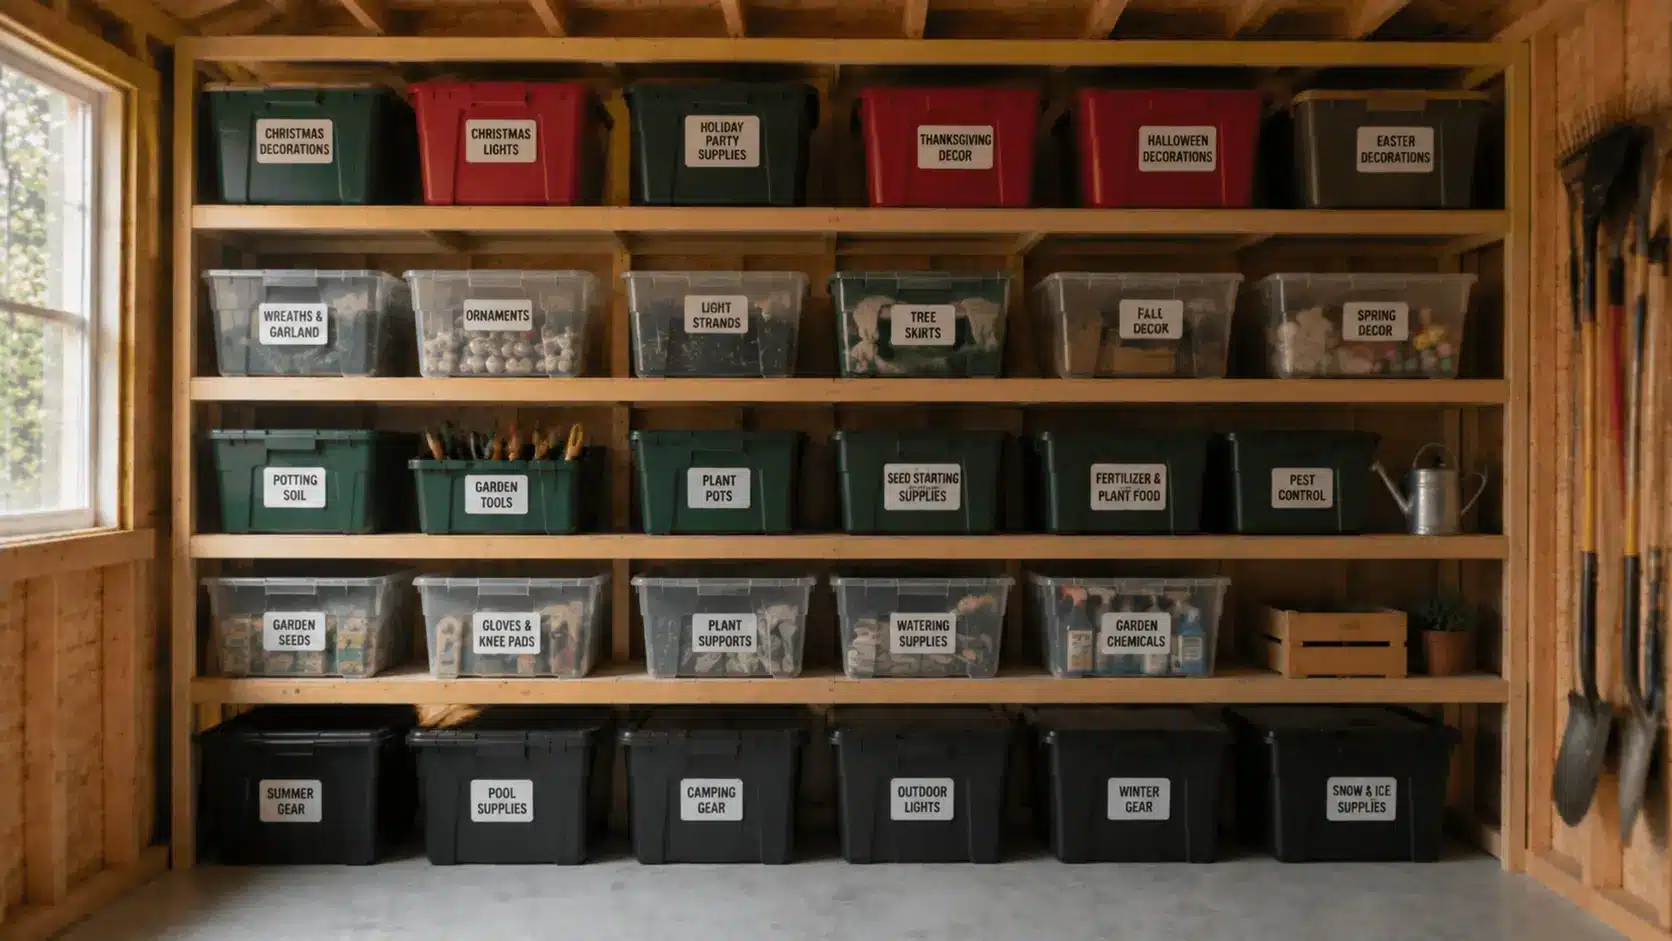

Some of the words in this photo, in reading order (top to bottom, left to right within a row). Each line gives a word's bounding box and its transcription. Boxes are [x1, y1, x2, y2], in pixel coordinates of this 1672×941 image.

[701, 122, 744, 133] HOLIDAY
[265, 128, 324, 139] CHRISTMAS
[471, 128, 531, 140] CHRISTMAS
[706, 135, 739, 146] PARTY
[921, 134, 991, 146] THANKSGIVING
[1148, 135, 1208, 146] HALLOWEEN
[1377, 135, 1415, 147] EASTER
[260, 144, 329, 155] DECORATIONS
[484, 144, 519, 155] LIGHTS
[698, 149, 747, 160] SUPPLIES
[939, 149, 972, 161] DECOR
[1143, 151, 1212, 162] DECORATIONS
[1361, 152, 1431, 163] DECORATIONS
[702, 302, 732, 313] LIGHT
[264, 310, 312, 322] WREATHS
[316, 310, 322, 322] &
[466, 310, 530, 321] ORNAMENTS
[911, 311, 936, 323] TREE
[1358, 310, 1396, 321] SPRING
[693, 317, 741, 328] STRANDS
[270, 326, 319, 338] GARLAND
[905, 327, 941, 339] SKIRTS
[1358, 325, 1392, 336] DECOR
[273, 474, 317, 485] POTTING
[703, 475, 736, 486] PLANT
[888, 472, 911, 484] SEED
[913, 472, 959, 484] STARTING
[1096, 472, 1151, 484] FERTILIZER
[1154, 472, 1161, 484] &
[1290, 474, 1315, 486] PEST
[476, 481, 518, 492] GARDEN
[283, 490, 306, 500] SOIL
[706, 490, 732, 502] POTS
[899, 490, 947, 502] SUPPLIES
[1099, 490, 1131, 502] PLANT
[1133, 490, 1160, 502] FOOD
[1278, 490, 1327, 501] CONTROL
[481, 497, 513, 508] TOOLS
[273, 619, 315, 630] GARDEN
[483, 620, 522, 631] GLOVES
[525, 620, 532, 631] &
[709, 620, 742, 631] PLANT
[897, 620, 950, 631] WATERING
[1116, 620, 1158, 631] GARDEN
[279, 635, 310, 646] SEEDS
[479, 636, 506, 647] KNEE
[508, 636, 535, 647] PADS
[699, 635, 752, 647] SUPPORTS
[899, 636, 947, 647] SUPPLIES
[1107, 636, 1165, 647] CHEMICALS
[267, 788, 314, 799] SUMMER
[489, 787, 516, 799] POOL
[687, 787, 736, 798] CAMPING
[898, 786, 947, 797] OUTDOOR
[1119, 786, 1159, 798] WINTER
[1333, 785, 1363, 797] SNOW
[1375, 785, 1391, 797] ICE
[277, 804, 305, 815] GEAR
[478, 803, 527, 814] SUPPLIES
[698, 802, 725, 813] GEAR
[905, 801, 940, 813] LIGHTS
[1126, 801, 1153, 812] GEAR
[1338, 801, 1386, 813] SUPPLIES
